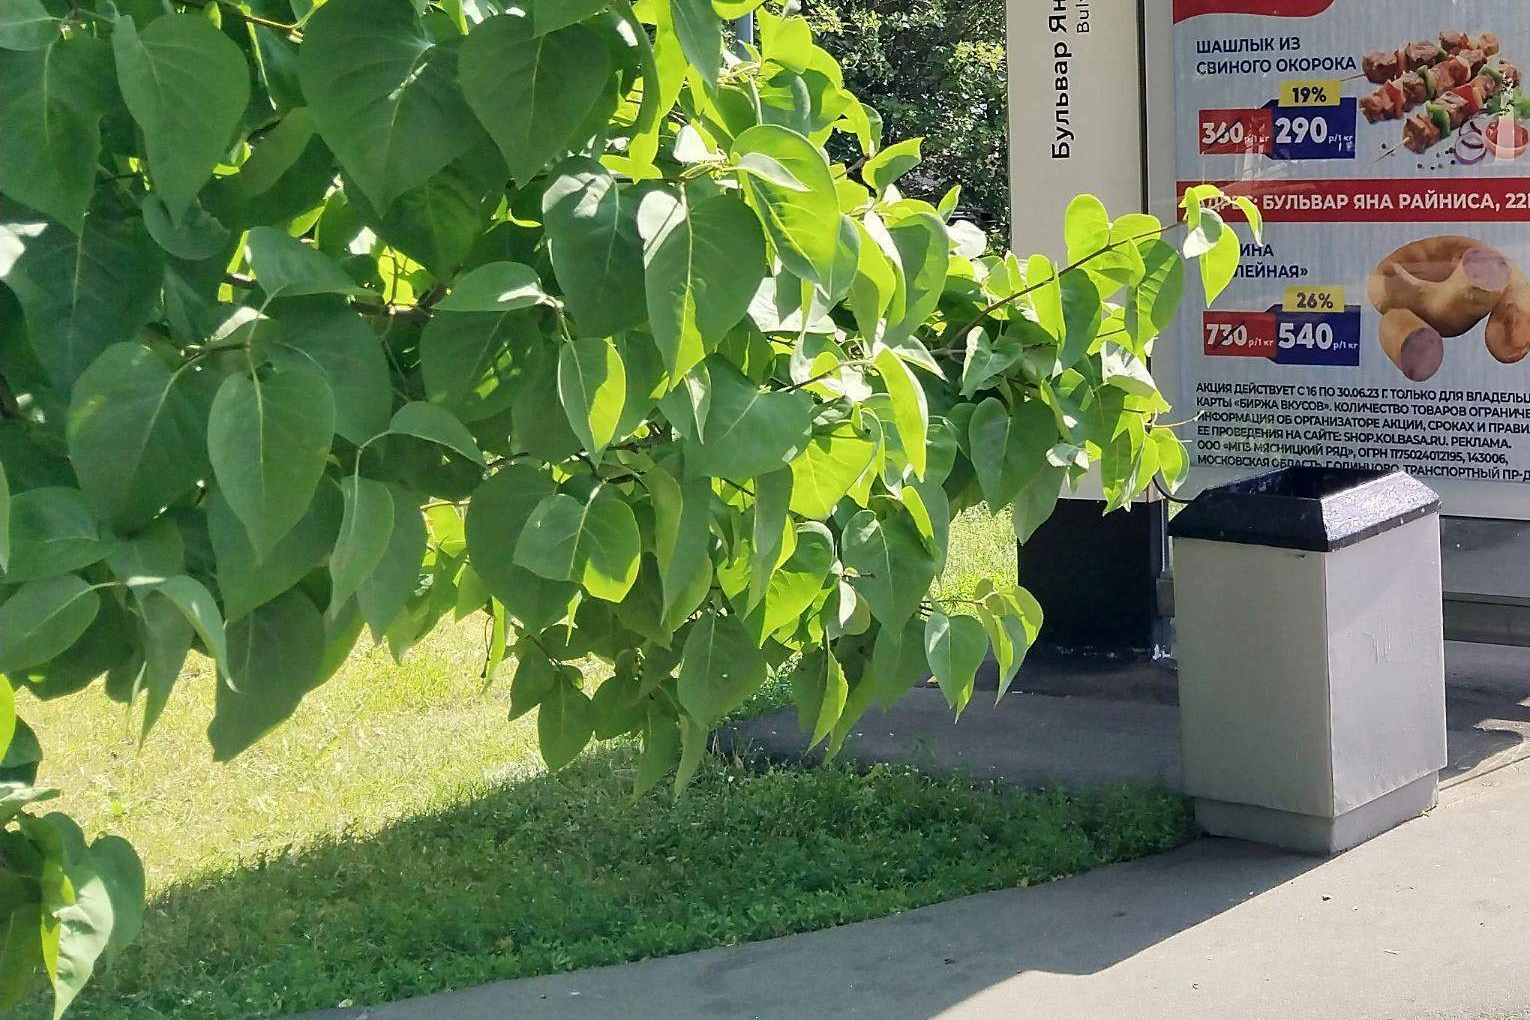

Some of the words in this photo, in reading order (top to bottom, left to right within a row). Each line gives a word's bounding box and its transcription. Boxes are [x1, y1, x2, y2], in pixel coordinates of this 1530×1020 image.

[1196, 37, 1275, 53] ШАШЛЫК
[1279, 36, 1301, 51] ИЗ
[1196, 59, 1272, 75] СВИНОГО
[1276, 56, 1357, 72] ОКОРОКА
[1051, 42, 1075, 159] Бульвар
[1292, 86, 1327, 103] 19%
[1274, 116, 1328, 144] 290
[1263, 194, 1349, 210] БУЛЬВАР
[1353, 194, 1393, 210] ЯНА
[1400, 190, 1501, 212] РАЙНИСА,
[1233, 262, 1308, 279] ЛЕЙНАЯ»
[1296, 292, 1334, 309] 26%
[1206, 323, 1248, 346] 730
[1278, 322, 1333, 350] 540
[1196, 383, 1232, 394] АКЦИЯ
[1234, 383, 1295, 396] ДЕЙСТВУЕТ
[1319, 387, 1335, 397] ПО
[1337, 387, 1379, 398] 30.06.23
[1381, 389, 1389, 399] Г.
[1390, 389, 1437, 401] ТОЛЬКО
[1439, 391, 1464, 402] ДЛЯ
[1197, 397, 1232, 408] КАРТЫ
[1234, 398, 1279, 410] «БИРЖА
[1280, 400, 1332, 412] ВКУСОВ».
[1334, 402, 1409, 415] КОЛИЧЕСТВО
[1411, 404, 1467, 416] ТОВАРОВ
[1197, 411, 1275, 424] ИНФОРМАЦИЯ
[1277, 414, 1292, 425] ОБ
[1294, 415, 1380, 428] ОРГАНИЗАТОРЕ
[1382, 419, 1426, 431] АКЦИИ,
[1428, 420, 1474, 432] СРОКАХ
[1477, 422, 1486, 432] И
[1197, 426, 1210, 436] ЕЕ
[1212, 426, 1283, 439] ПРОВЕДЕНИЯ
[1285, 429, 1301, 439] НА
[1303, 428, 1342, 441] САЙТЕ:
[1451, 437, 1512, 448] РЕКЛАМА.
[1197, 440, 1220, 450] ООО
[1254, 442, 1323, 456] МЯСНИЦКИЙ
[1326, 446, 1356, 459] РЯД»,
[1358, 448, 1388, 459] ОГРН
[1467, 452, 1508, 465] 143006,
[1197, 454, 1269, 467] МОСКОВСКАЯ
[1403, 464, 1500, 479] ТРАНСПОРТНЫЙ
